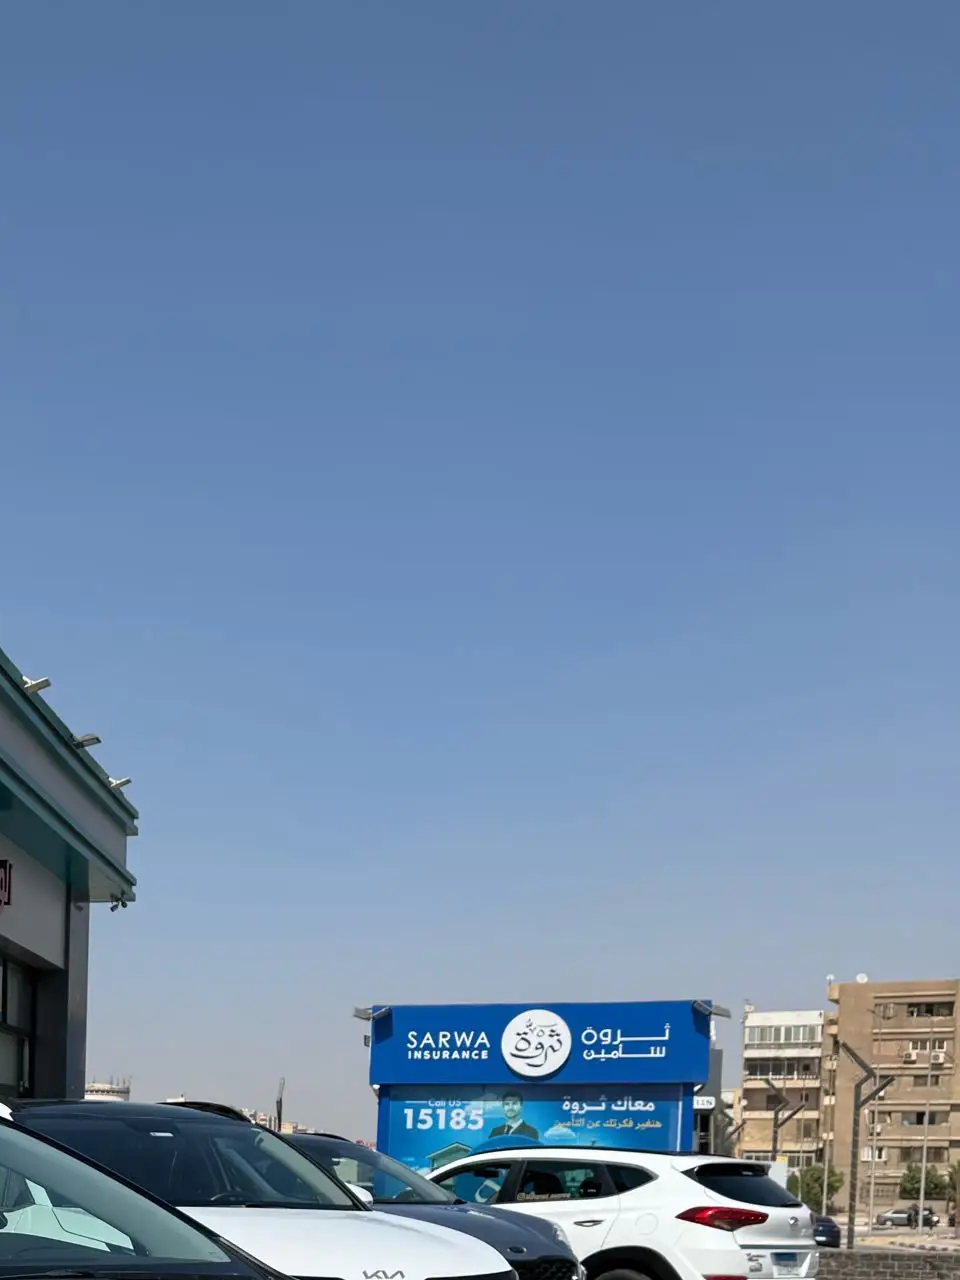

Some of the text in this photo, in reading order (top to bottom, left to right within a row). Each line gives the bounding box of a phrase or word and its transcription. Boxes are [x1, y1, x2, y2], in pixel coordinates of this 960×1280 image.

[406, 1031, 491, 1049] SARWA
[581, 1023, 671, 1045] ثروة
[407, 1050, 489, 1060] INSURANCE
[583, 1043, 666, 1062] للتأمين
[428, 1098, 446, 1107] Call
[562, 1095, 656, 1114] معاك ثروة
[403, 1108, 484, 1130] 15185
[362, 1270, 406, 1280] KIA
